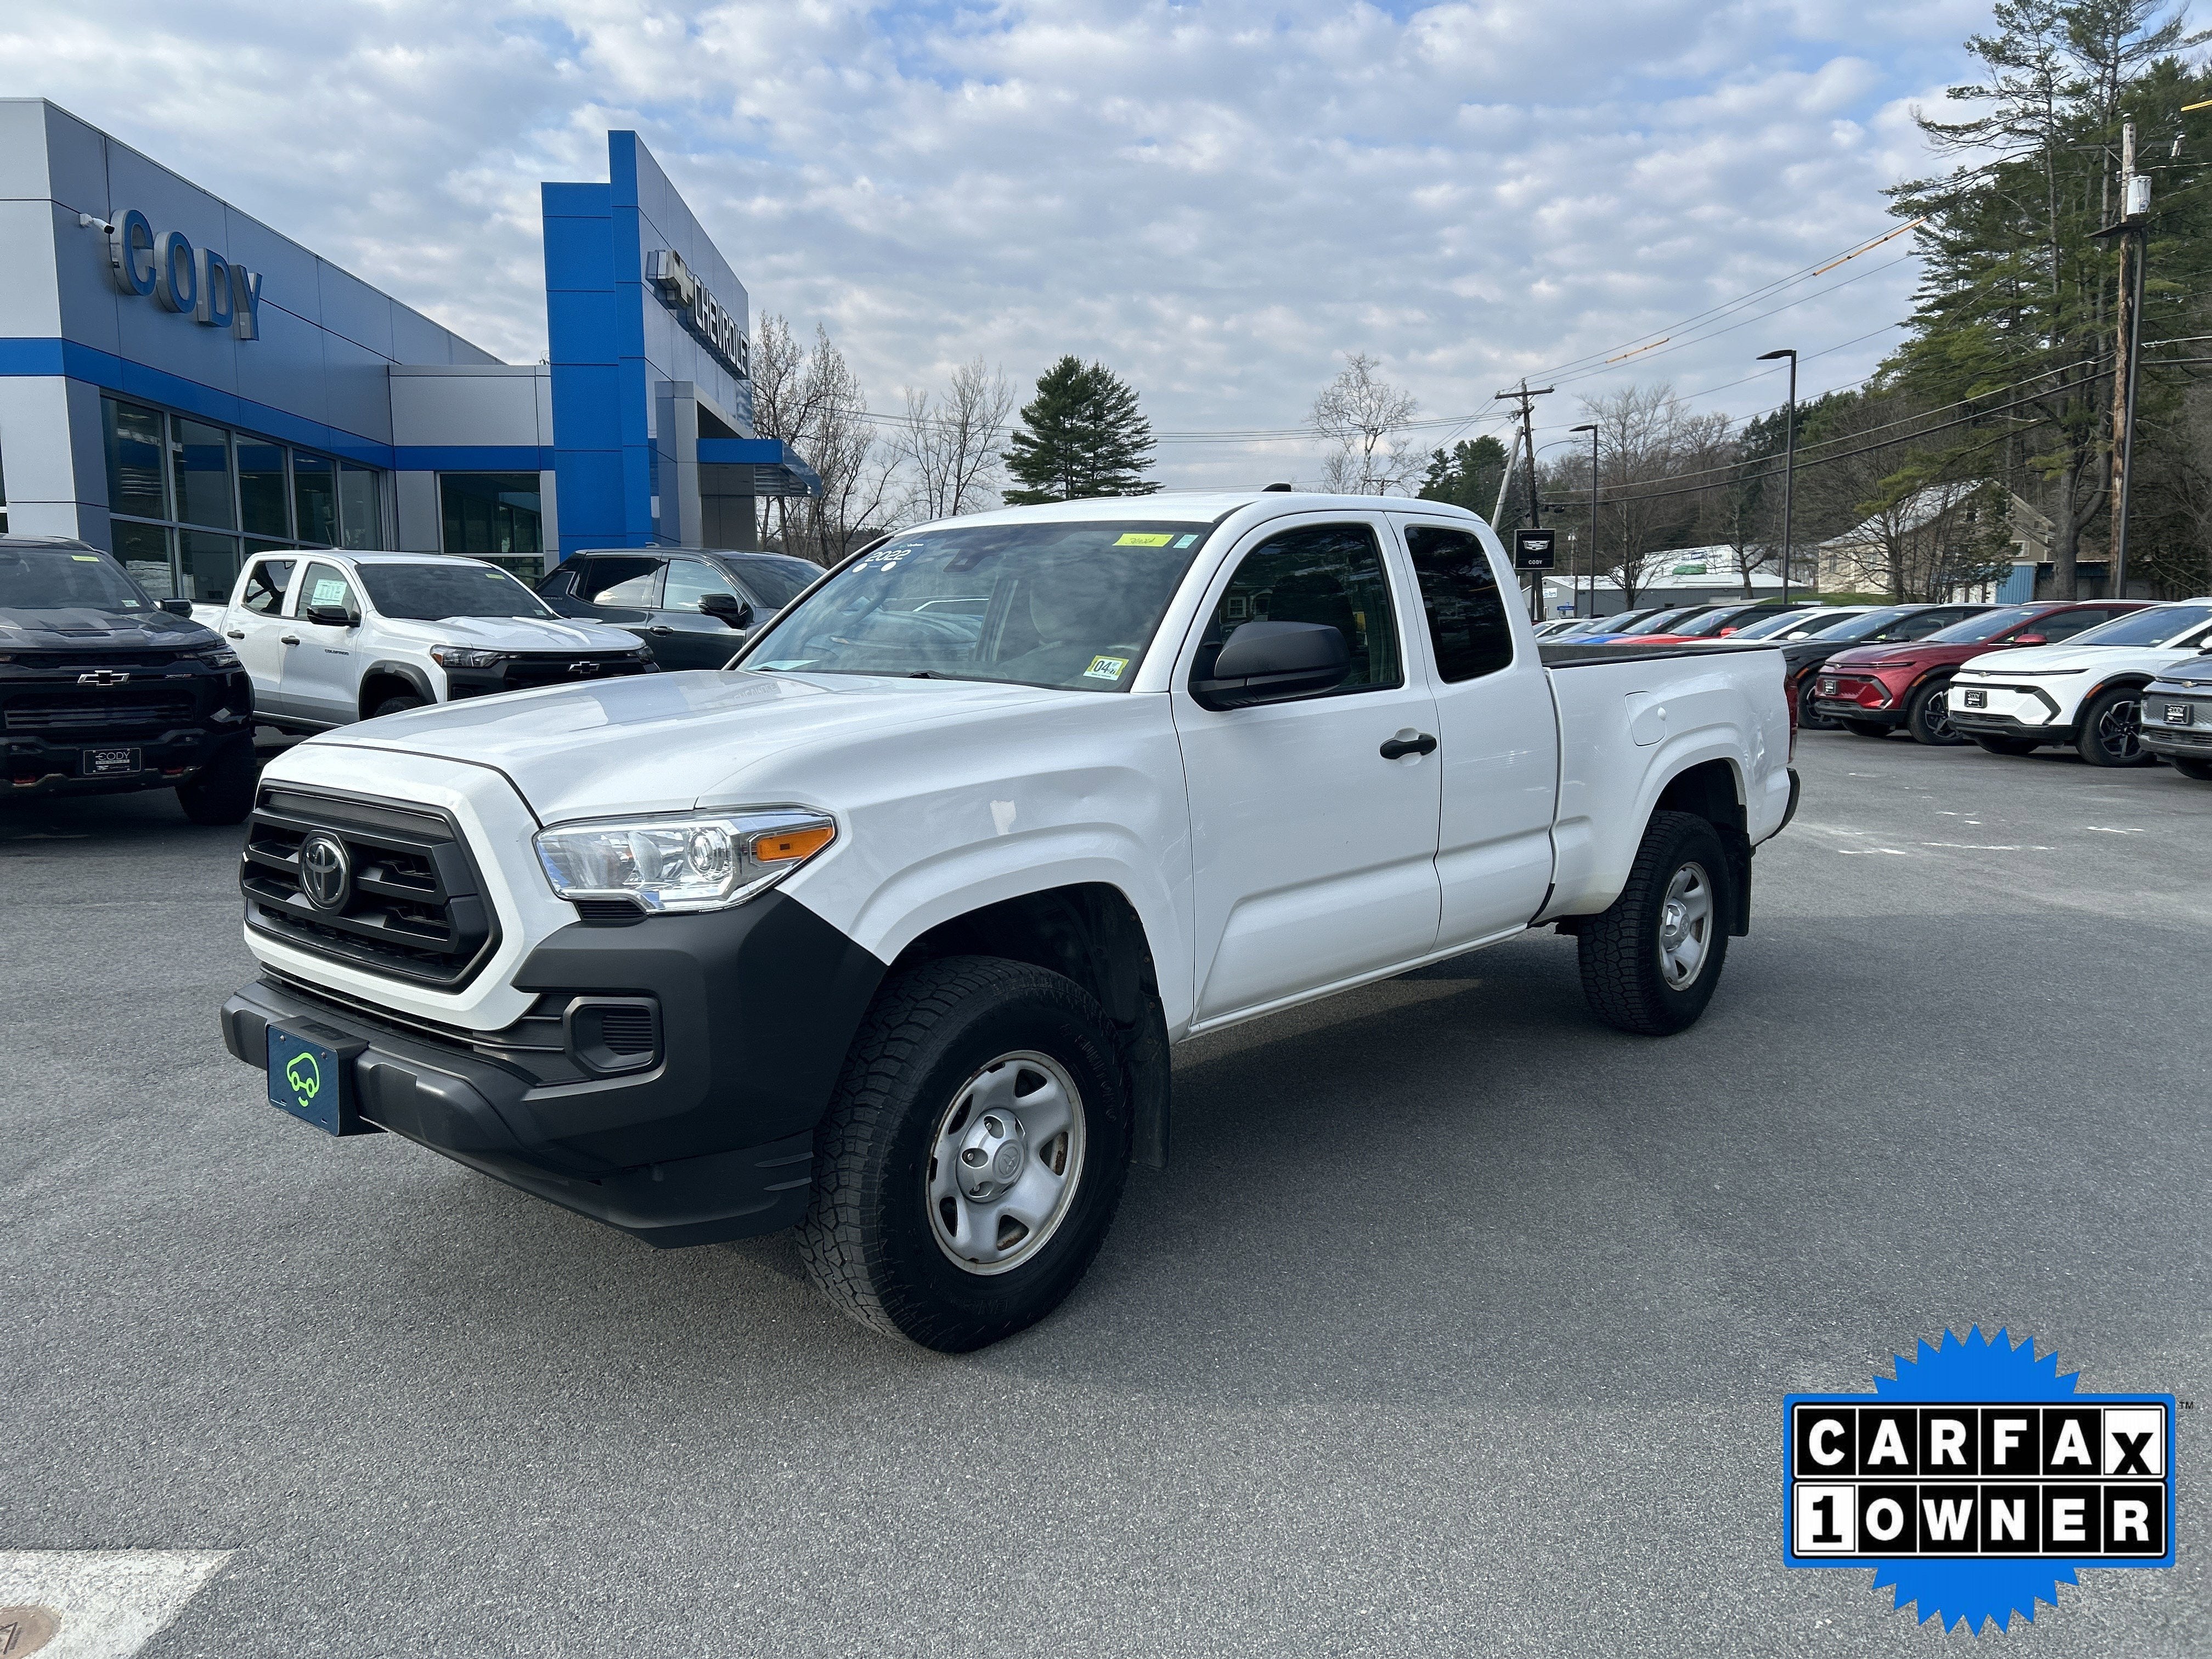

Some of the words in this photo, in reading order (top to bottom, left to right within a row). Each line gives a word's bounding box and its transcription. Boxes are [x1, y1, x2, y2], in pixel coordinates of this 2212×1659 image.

[110, 208, 262, 341] CODY
[865, 549, 911, 562] 2022
[1093, 661, 1113, 673] 04
[95, 752, 131, 761] CODY
